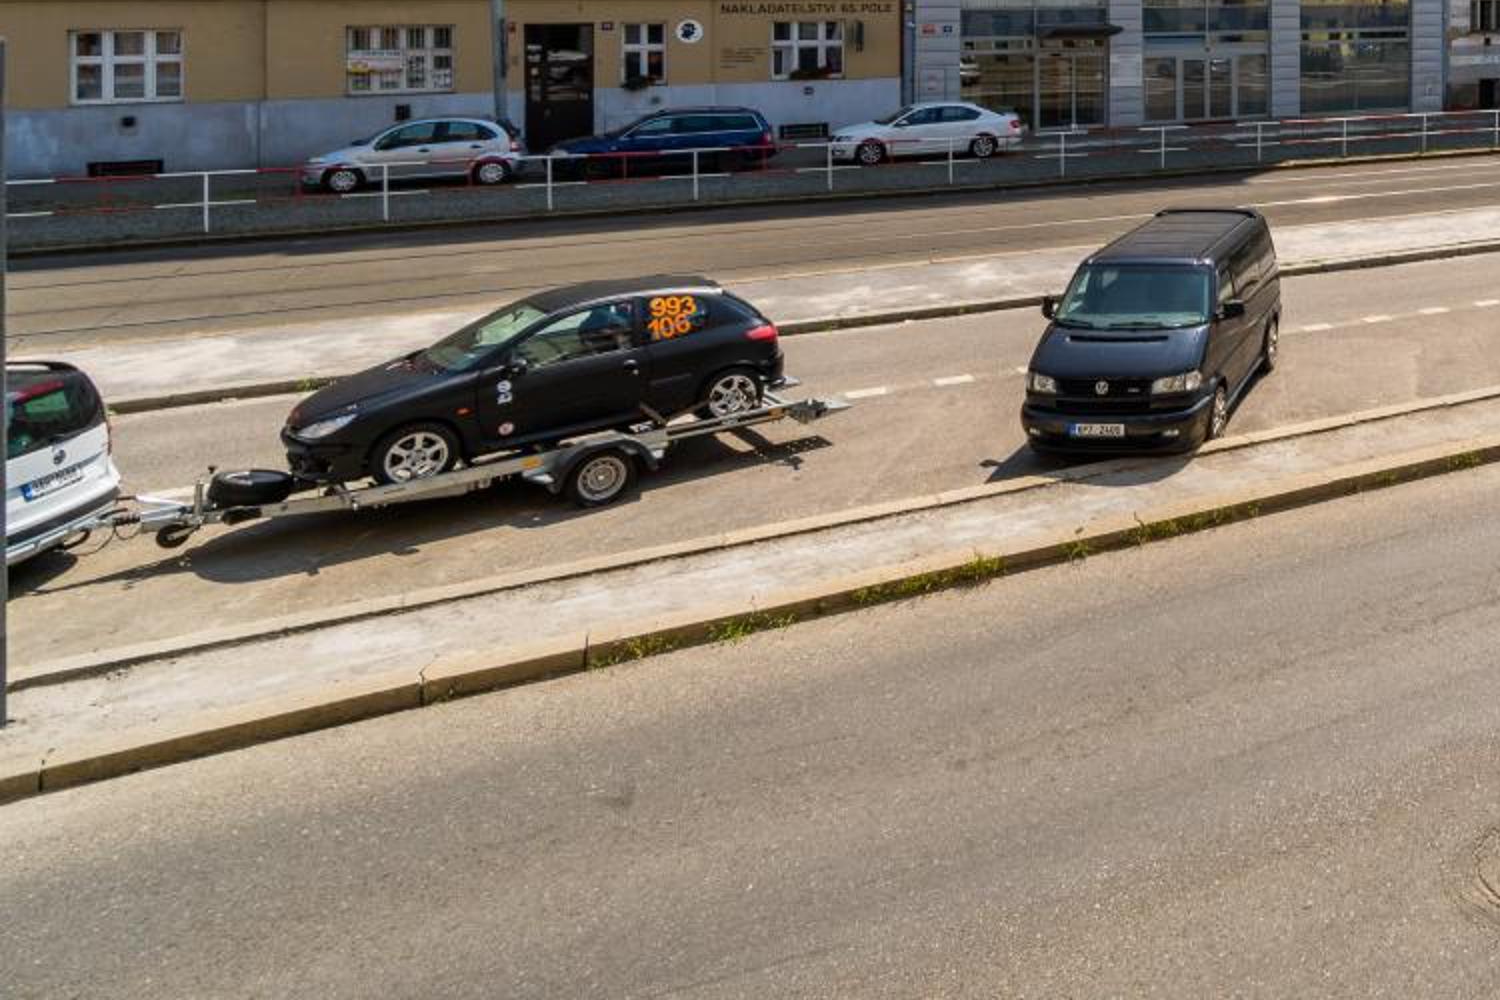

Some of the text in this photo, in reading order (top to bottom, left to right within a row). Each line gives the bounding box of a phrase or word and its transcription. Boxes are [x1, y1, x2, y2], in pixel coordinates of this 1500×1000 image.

[861, 3, 892, 13] POLE
[649, 296, 697, 316] 993
[647, 314, 691, 340] 106
